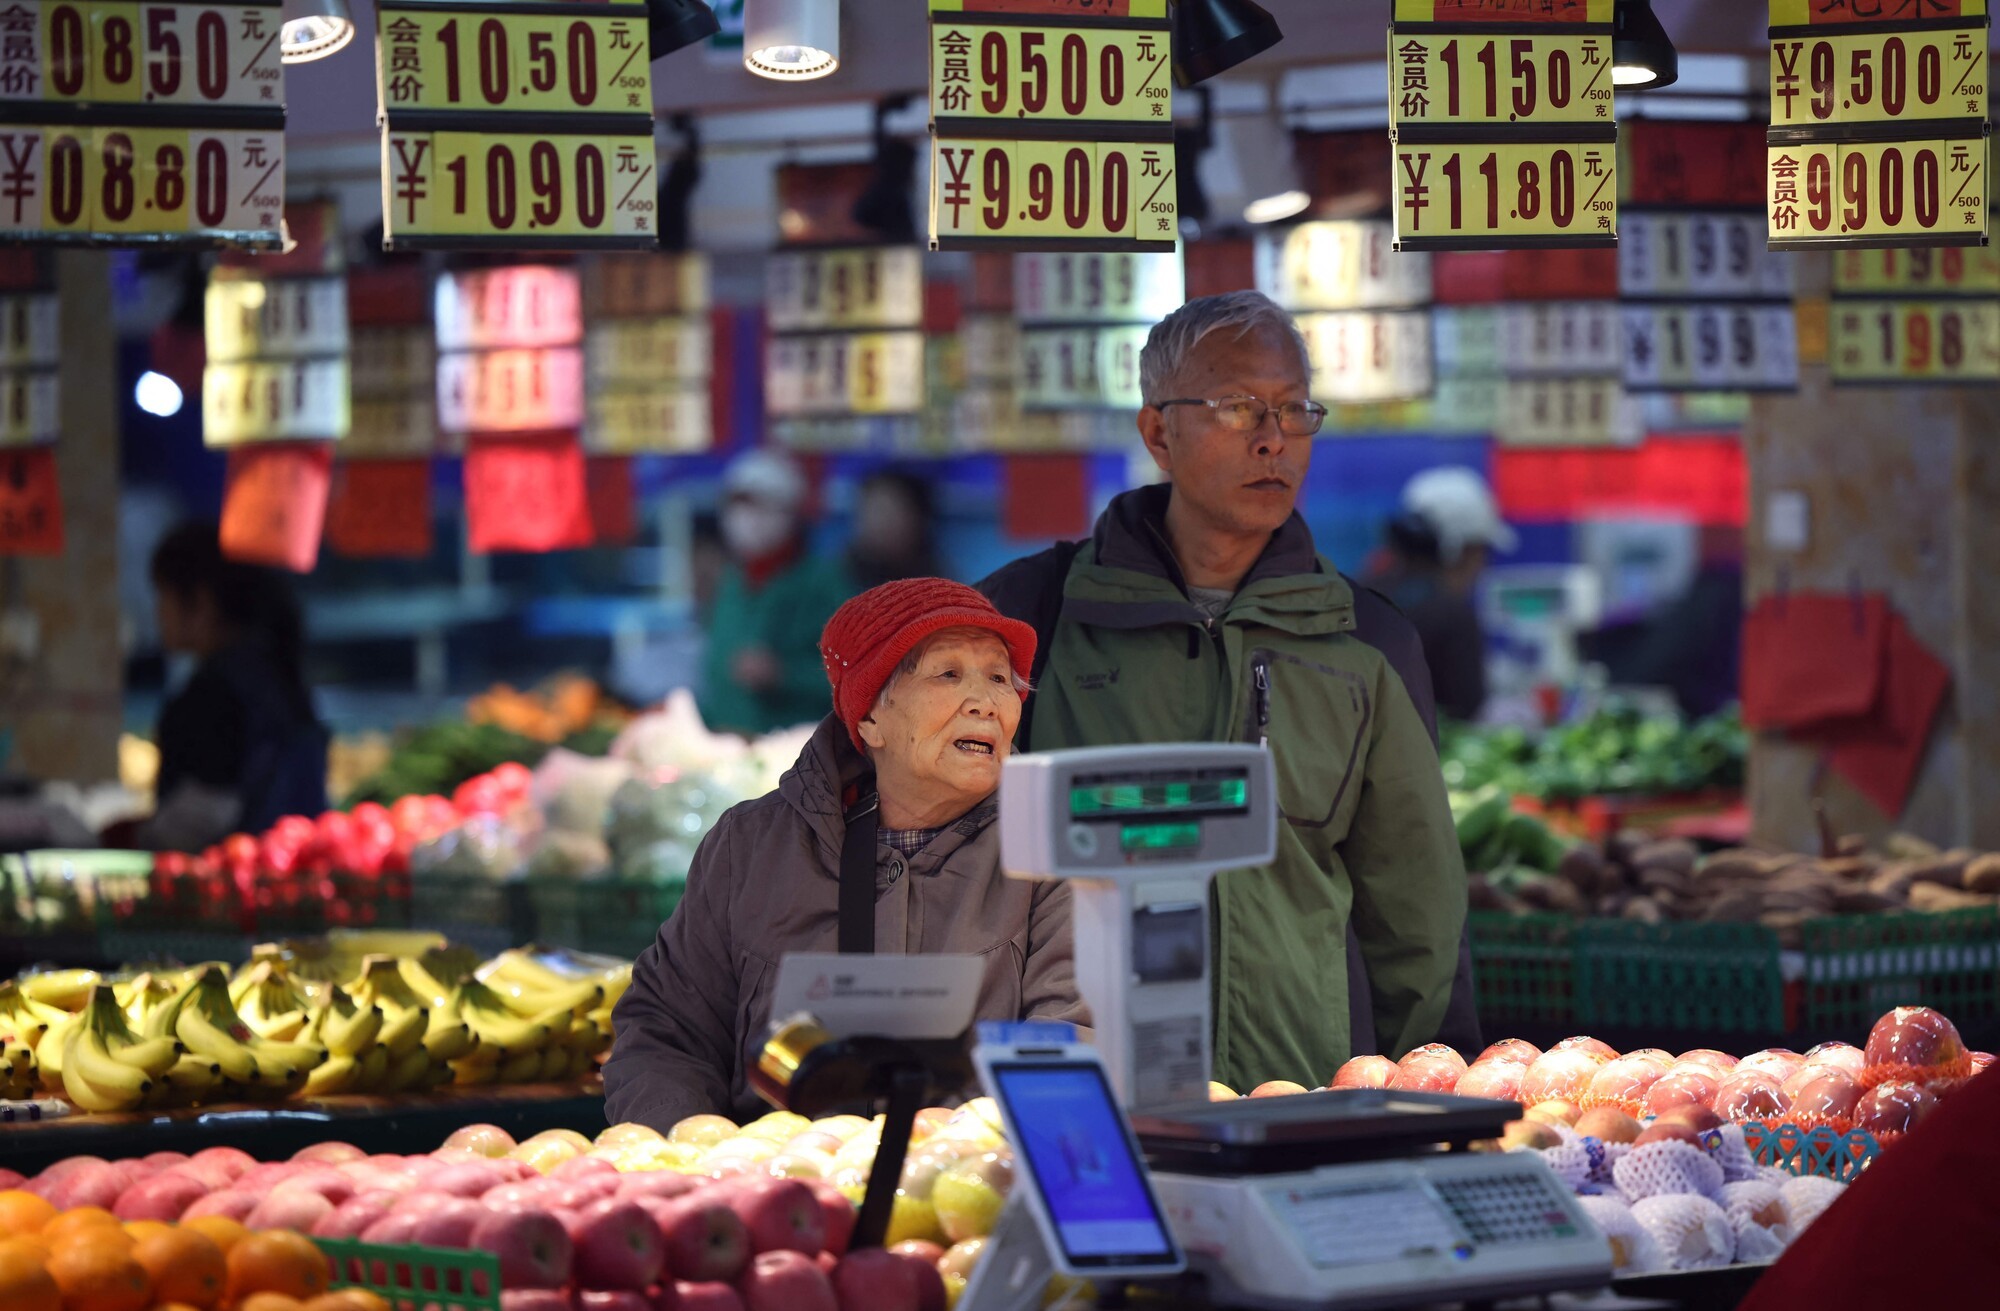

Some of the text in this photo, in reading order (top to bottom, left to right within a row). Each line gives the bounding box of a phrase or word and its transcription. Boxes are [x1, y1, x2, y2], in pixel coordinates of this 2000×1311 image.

[0, 4, 38, 93] 会员价
[51, 4, 228, 101] 08.50
[387, 16, 424, 102] 会员价
[436, 18, 598, 106] 10.50
[939, 30, 972, 111] 会员价
[981, 31, 1124, 118] 9.500
[1398, 40, 1430, 117] 会员价
[1440, 39, 1571, 121] 11.50
[1771, 154, 1800, 230] 会员价
[1807, 147, 1939, 233] 9.900
